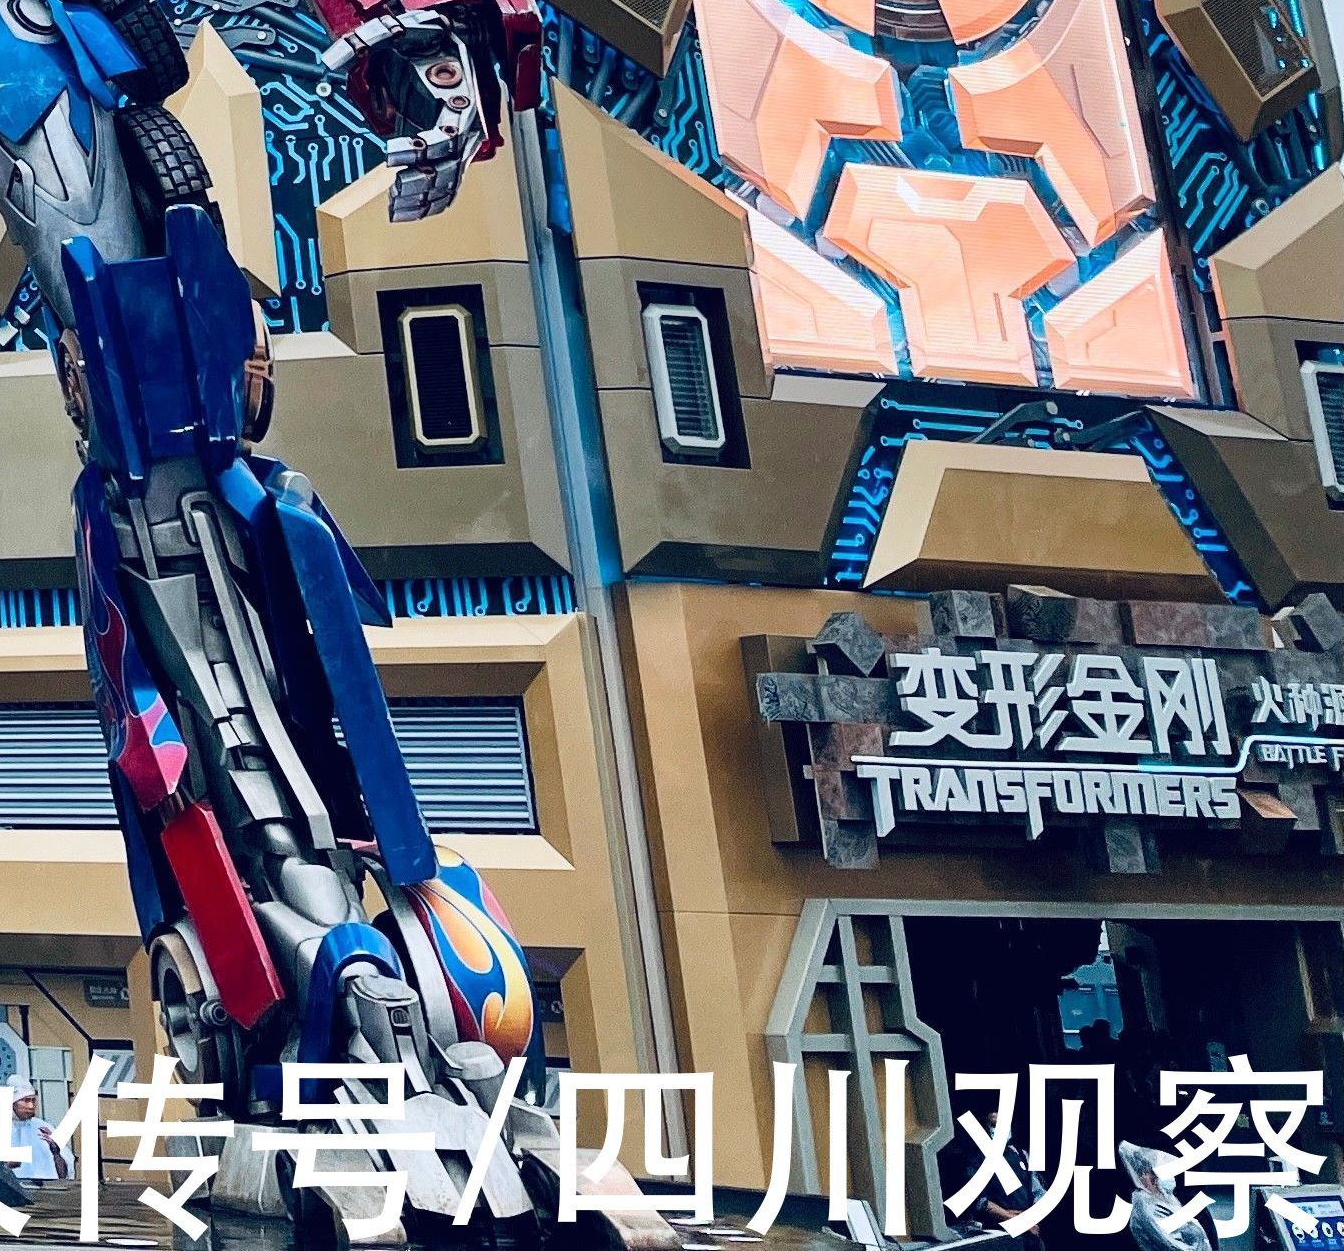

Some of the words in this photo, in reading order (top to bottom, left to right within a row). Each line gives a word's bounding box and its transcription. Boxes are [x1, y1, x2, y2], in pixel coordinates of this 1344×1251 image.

[889, 648, 1233, 756] 变形金刚
[1258, 744, 1328, 769] BATTLE
[857, 764, 1242, 840] TRANSFORMERS
